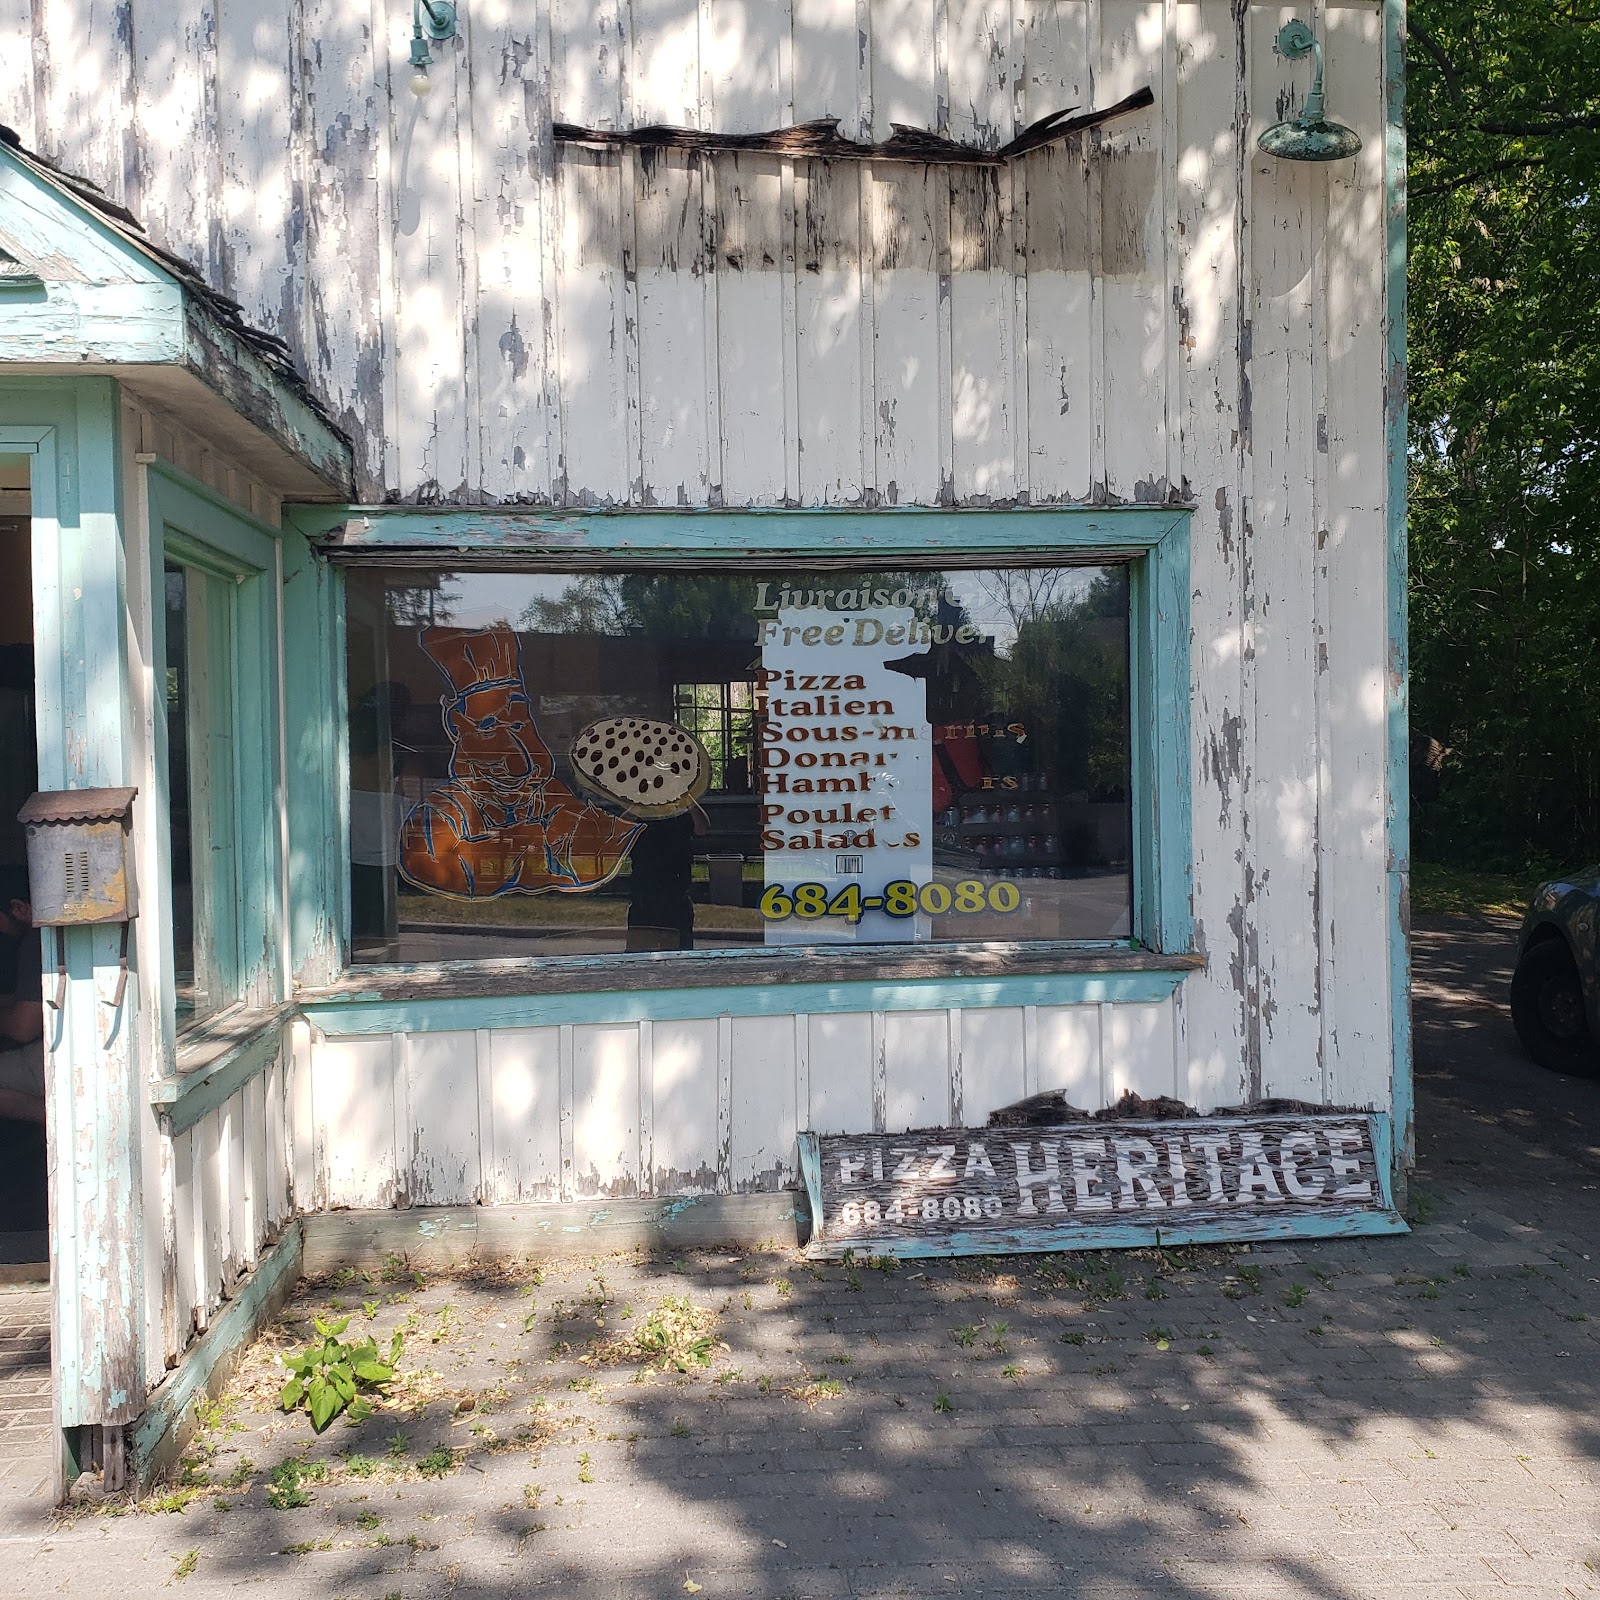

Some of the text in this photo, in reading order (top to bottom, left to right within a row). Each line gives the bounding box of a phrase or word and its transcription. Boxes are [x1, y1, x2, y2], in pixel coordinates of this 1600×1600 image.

[754, 618, 844, 647] Free
[755, 669, 866, 691] Pizza
[755, 695, 894, 717] Italien
[758, 880, 1021, 924] 684-8080
[839, 1144, 997, 1184] PIZZA
[842, 1197, 1003, 1226] 684-8080
